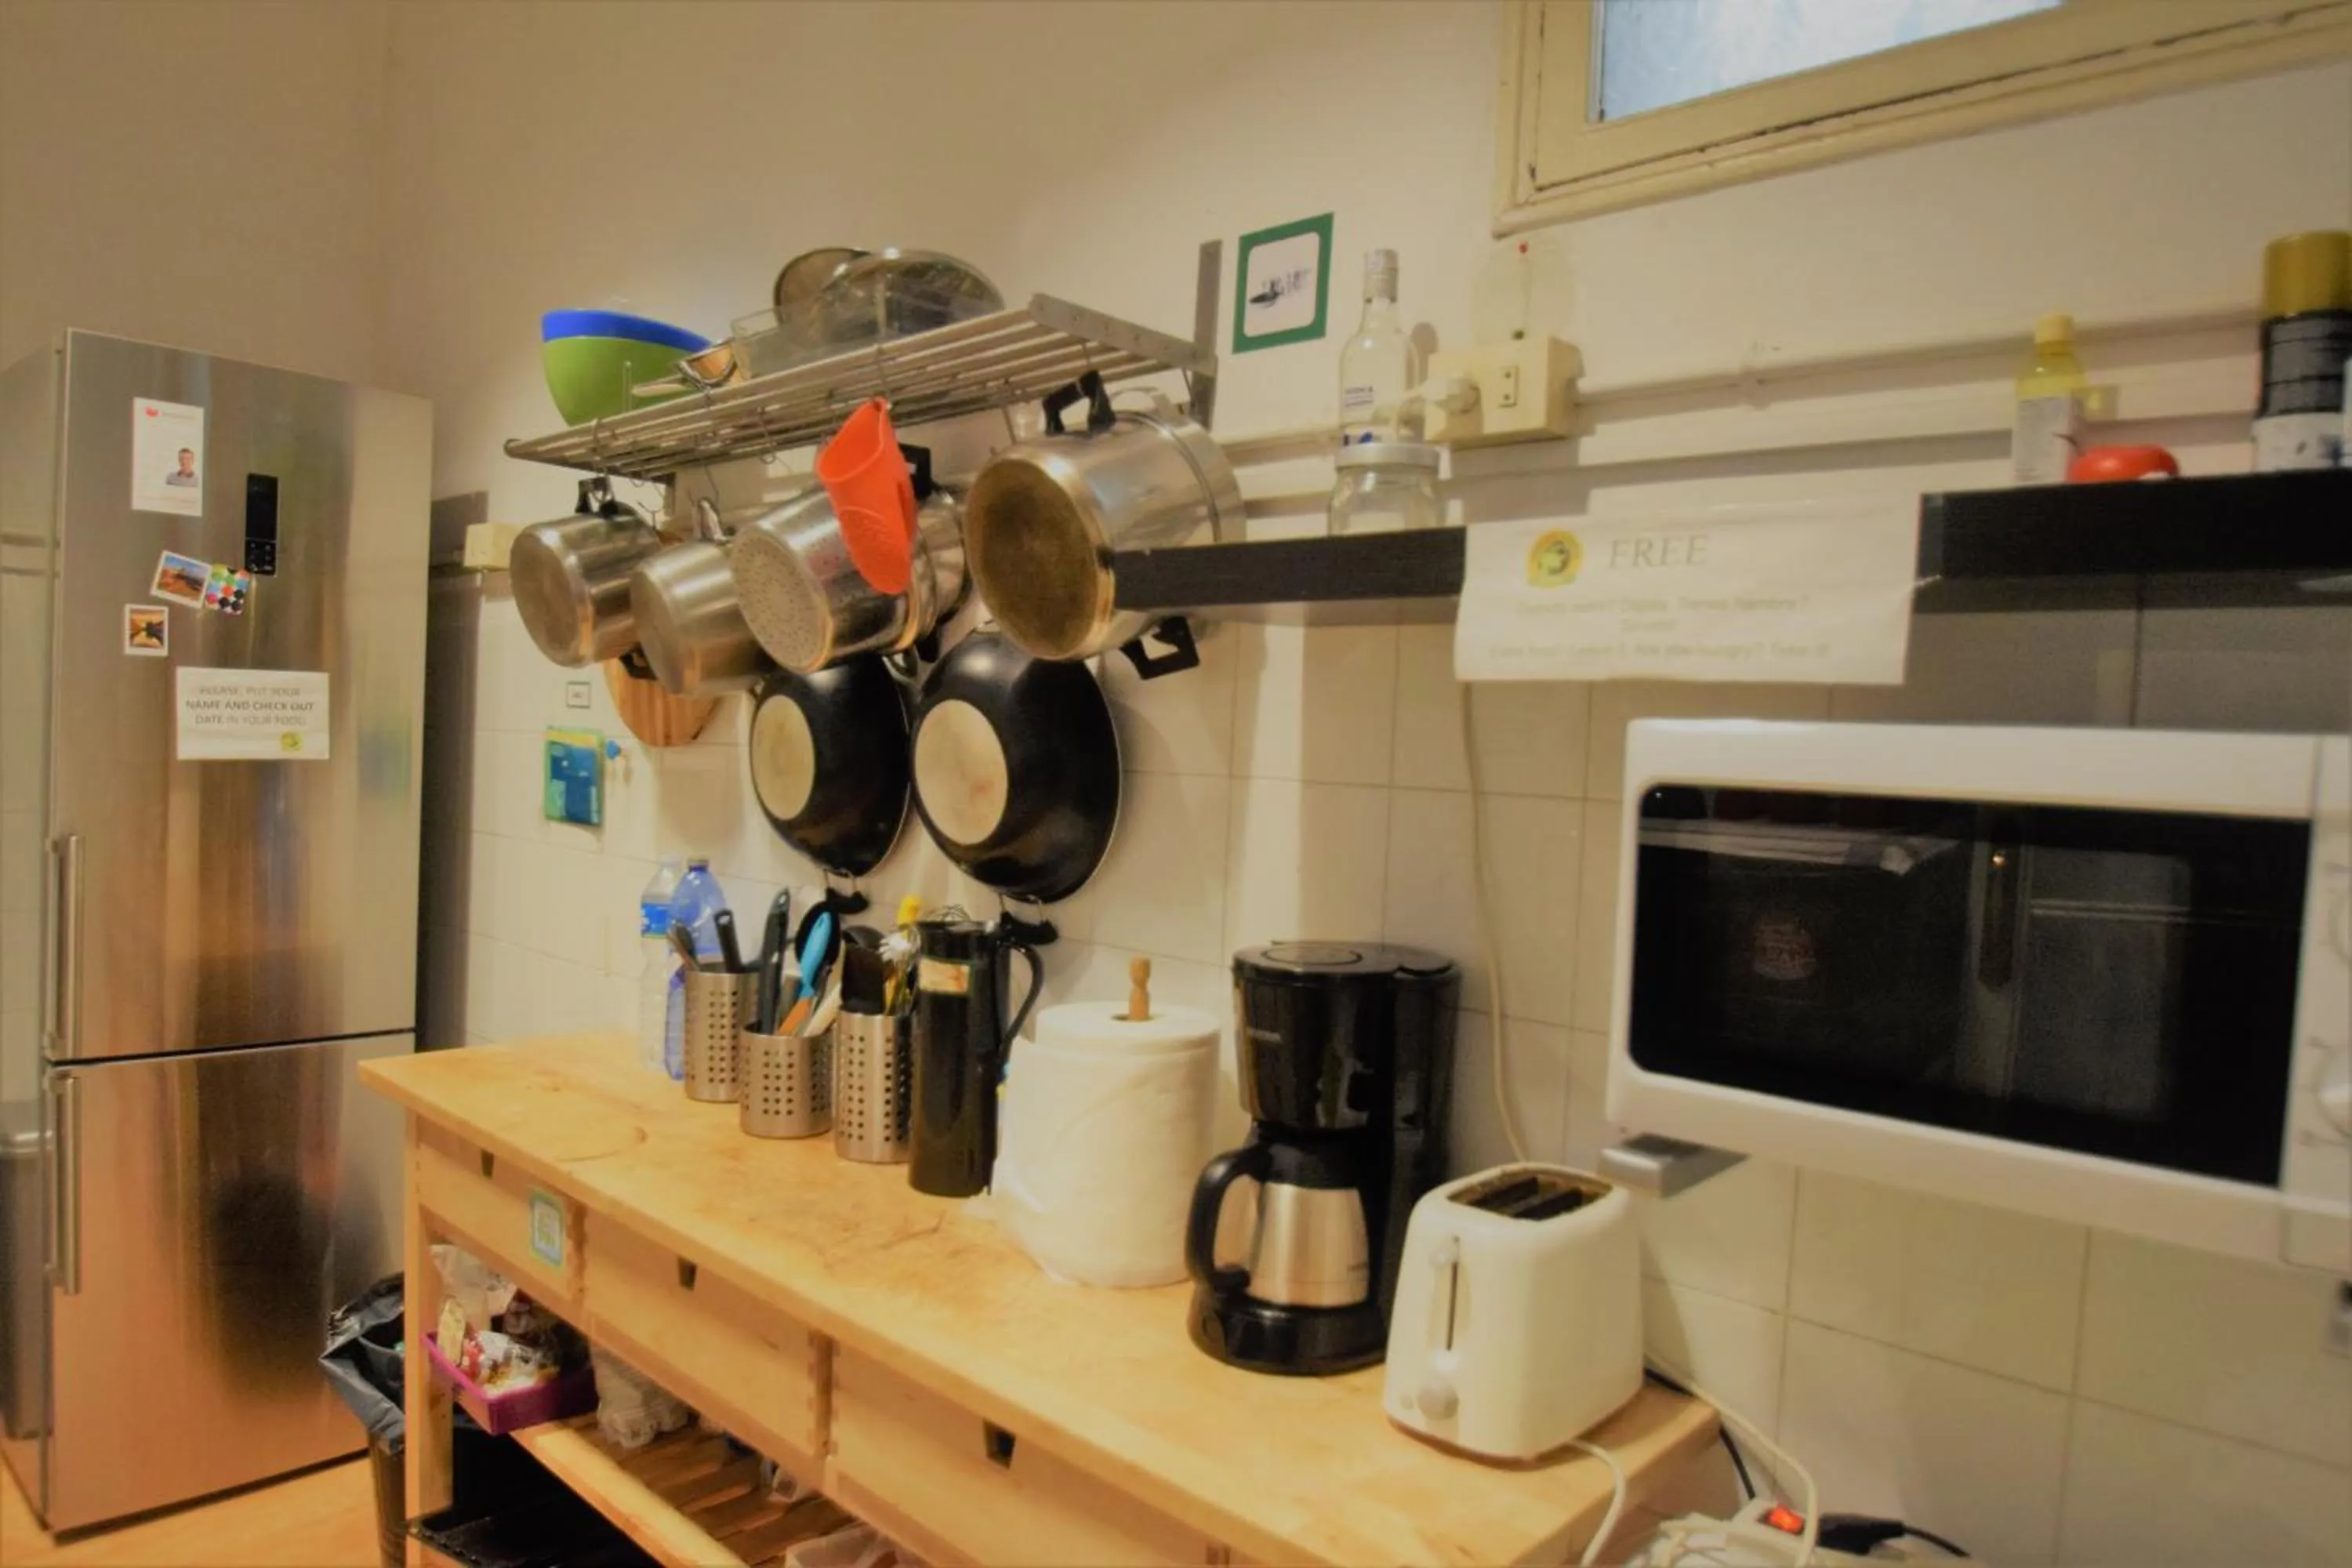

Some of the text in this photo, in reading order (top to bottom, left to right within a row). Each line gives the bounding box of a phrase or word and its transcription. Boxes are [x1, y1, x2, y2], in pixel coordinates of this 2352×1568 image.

[1608, 535, 1709, 569] FREE
[185, 699, 314, 712] NAME AND CHECK OUT
[195, 714, 223, 725] DATE
